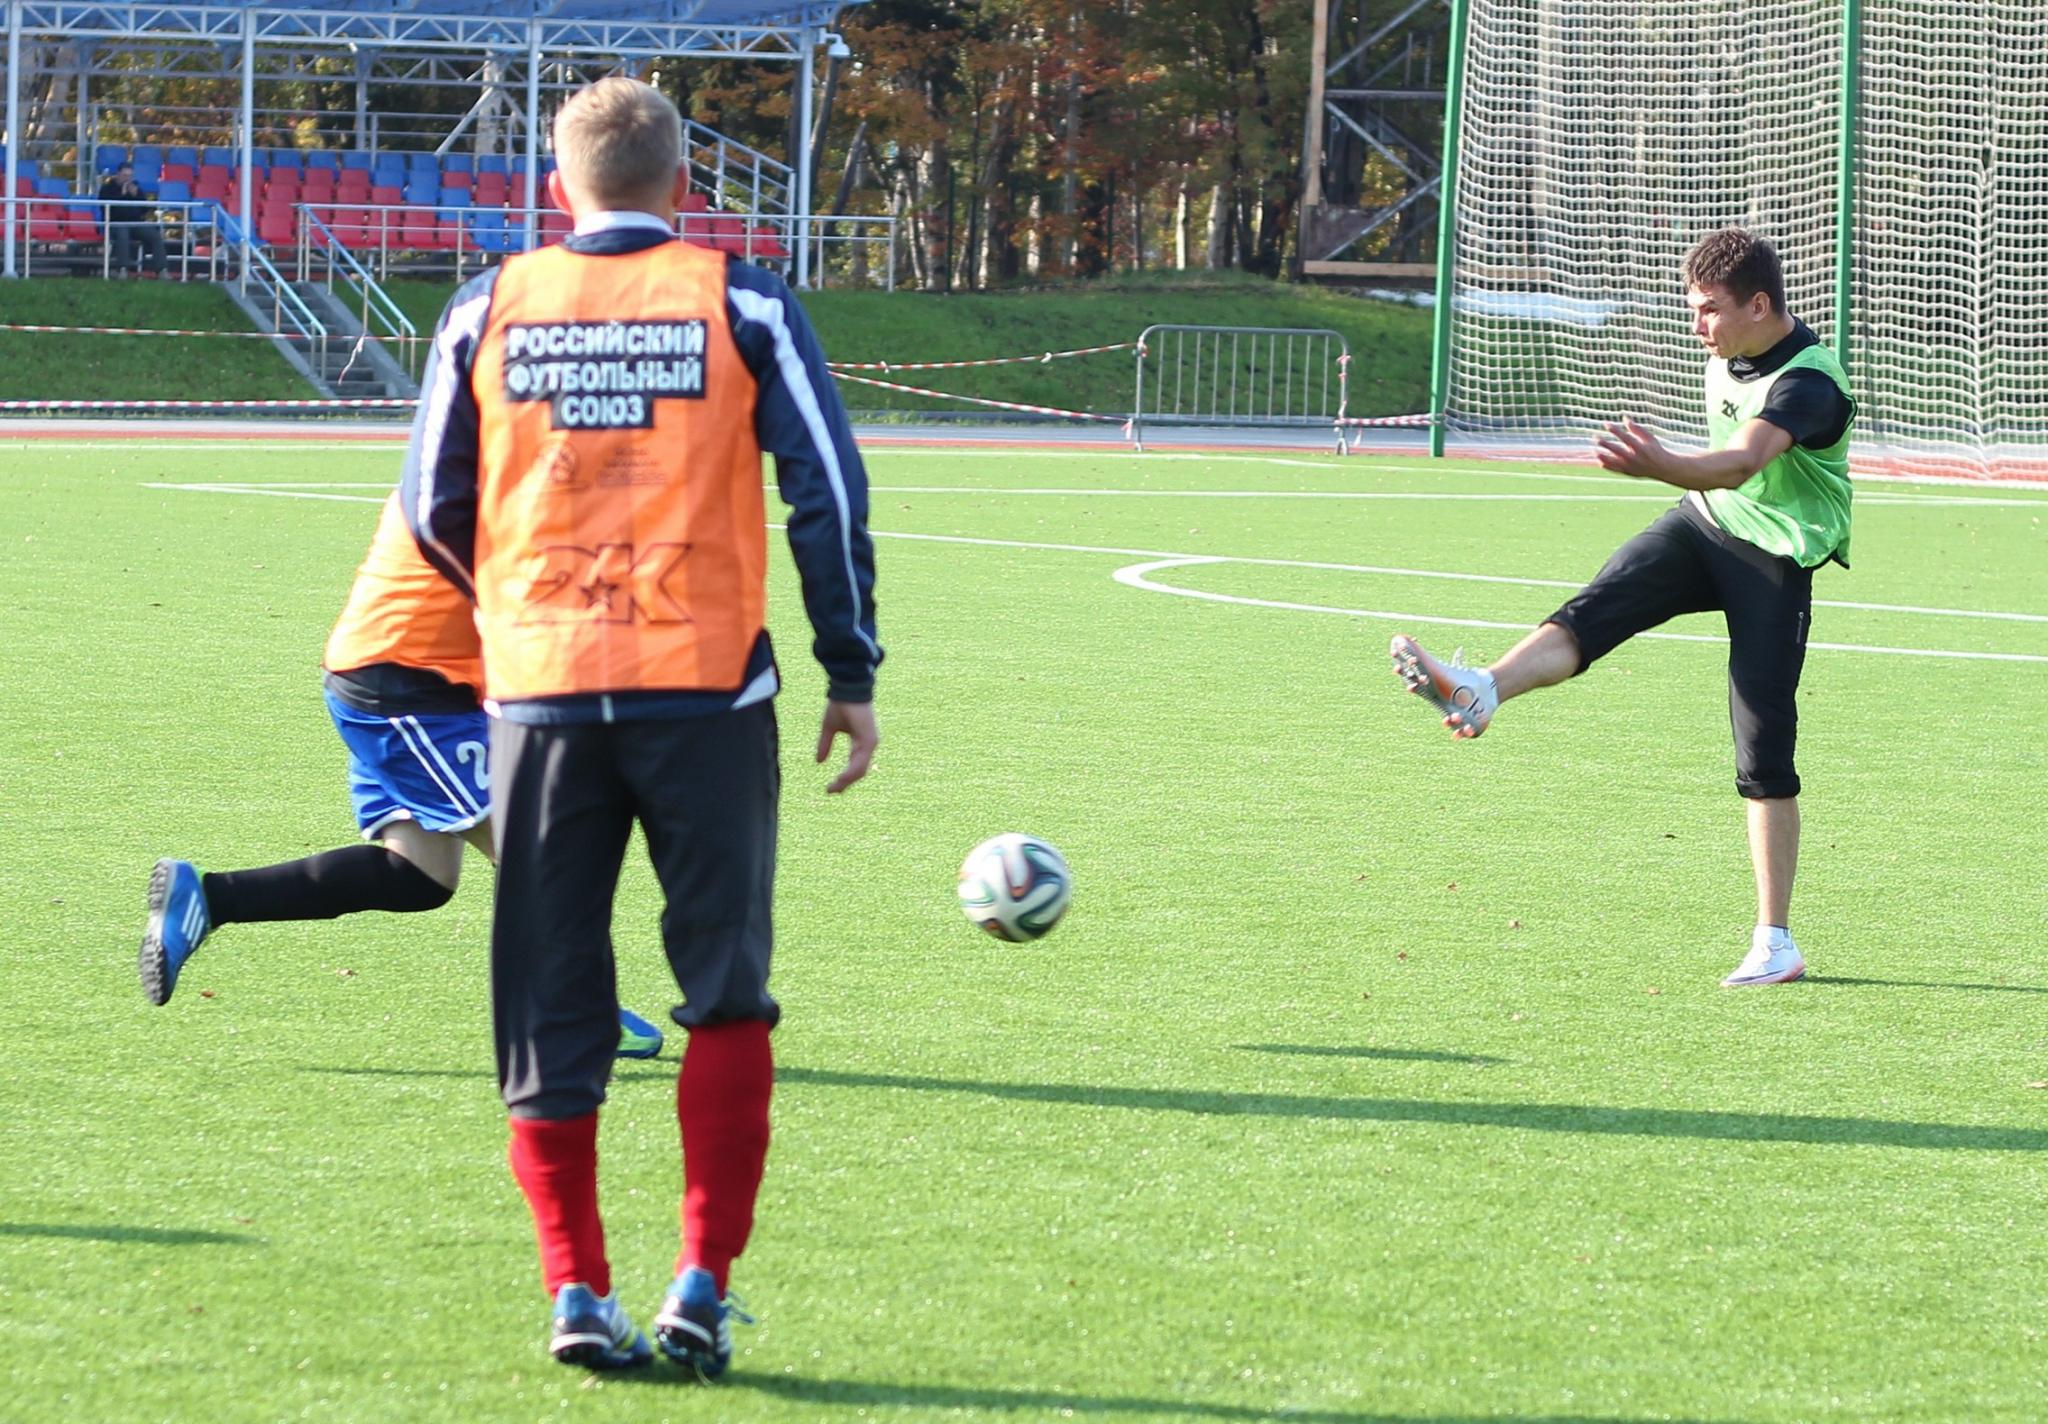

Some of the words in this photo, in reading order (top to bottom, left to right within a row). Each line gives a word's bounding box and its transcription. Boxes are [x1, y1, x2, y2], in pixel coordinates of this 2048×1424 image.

[508, 321, 704, 356] РОССИЙСКИЙ
[507, 357, 702, 393] ФУТБОЛЬНЫЙ
[560, 394, 645, 426] СОЮЗ
